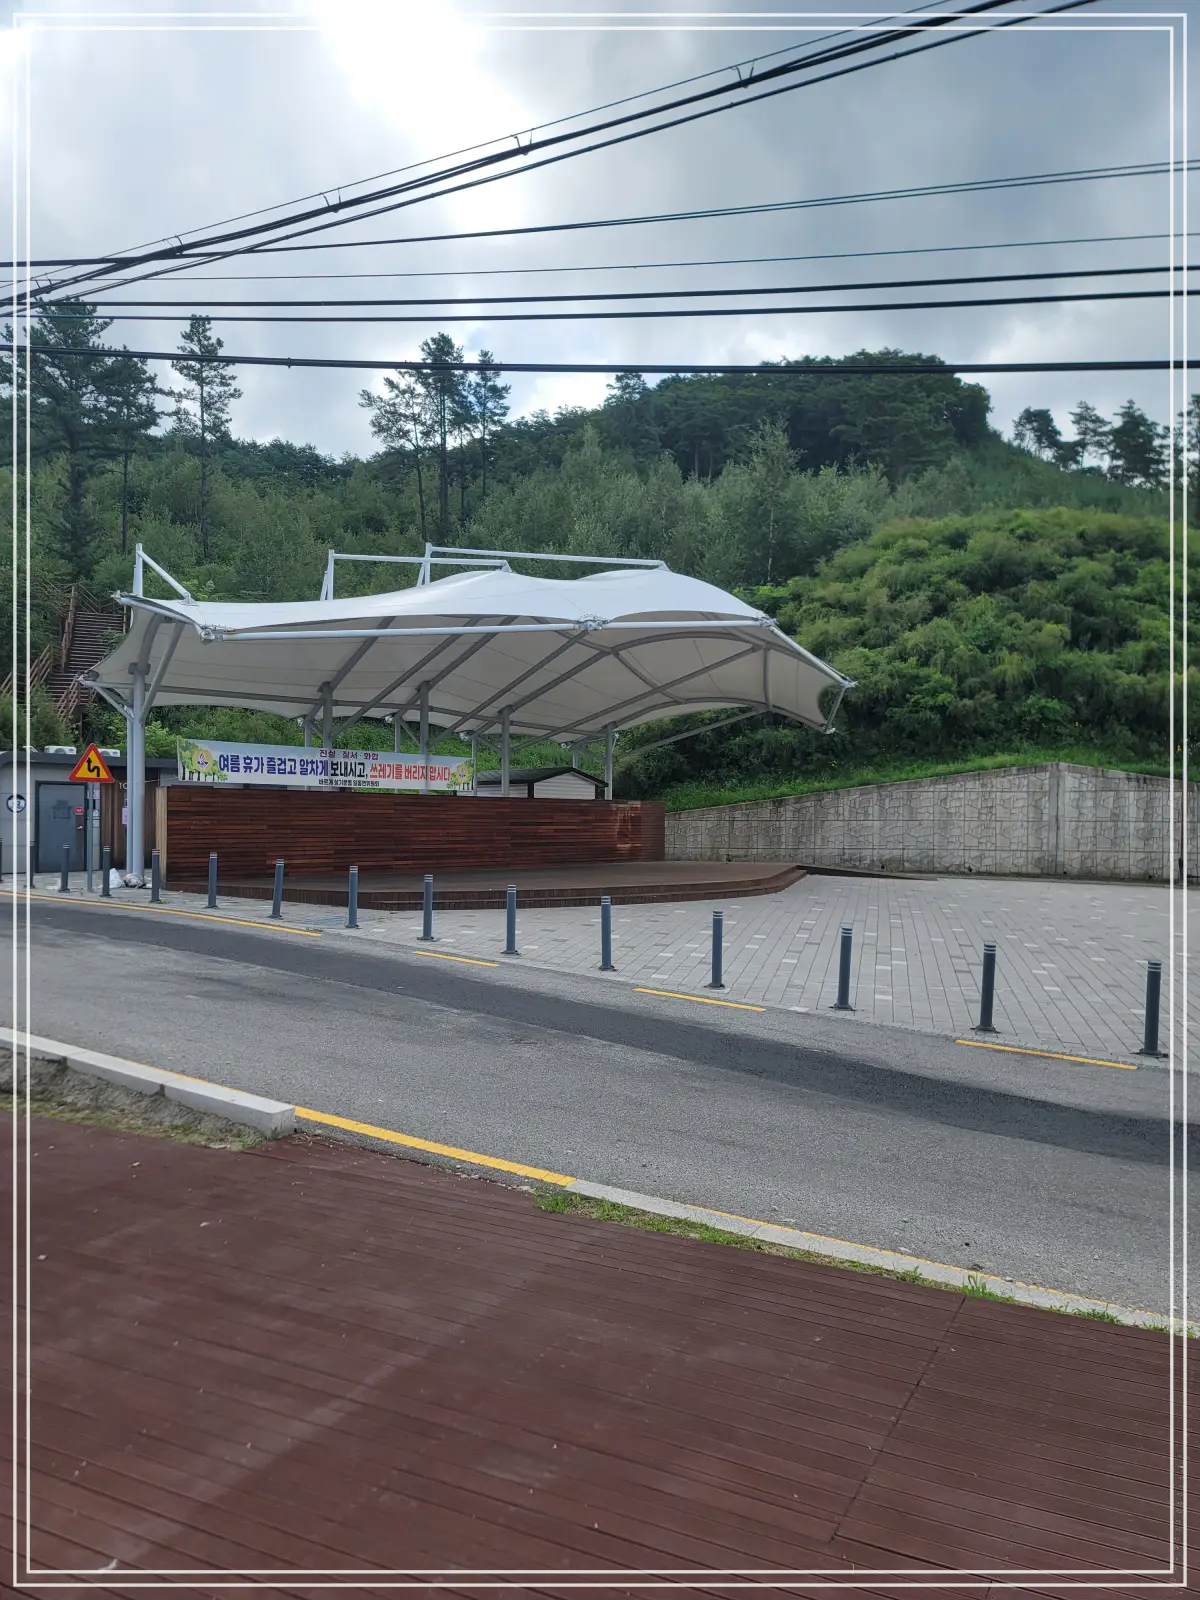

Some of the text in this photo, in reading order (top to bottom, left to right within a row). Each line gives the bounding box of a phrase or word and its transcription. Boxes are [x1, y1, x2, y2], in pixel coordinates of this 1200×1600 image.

[319, 749, 379, 761] 진실 질서 화합
[218, 754, 240, 773] 여름
[243, 755, 264, 774] 휴가
[266, 757, 297, 775] 즐겁고
[299, 758, 329, 777] 알차게
[330, 760, 368, 779] 보내시고,
[369, 763, 403, 780] 쓰레기를
[404, 764, 428, 781] 버리지
